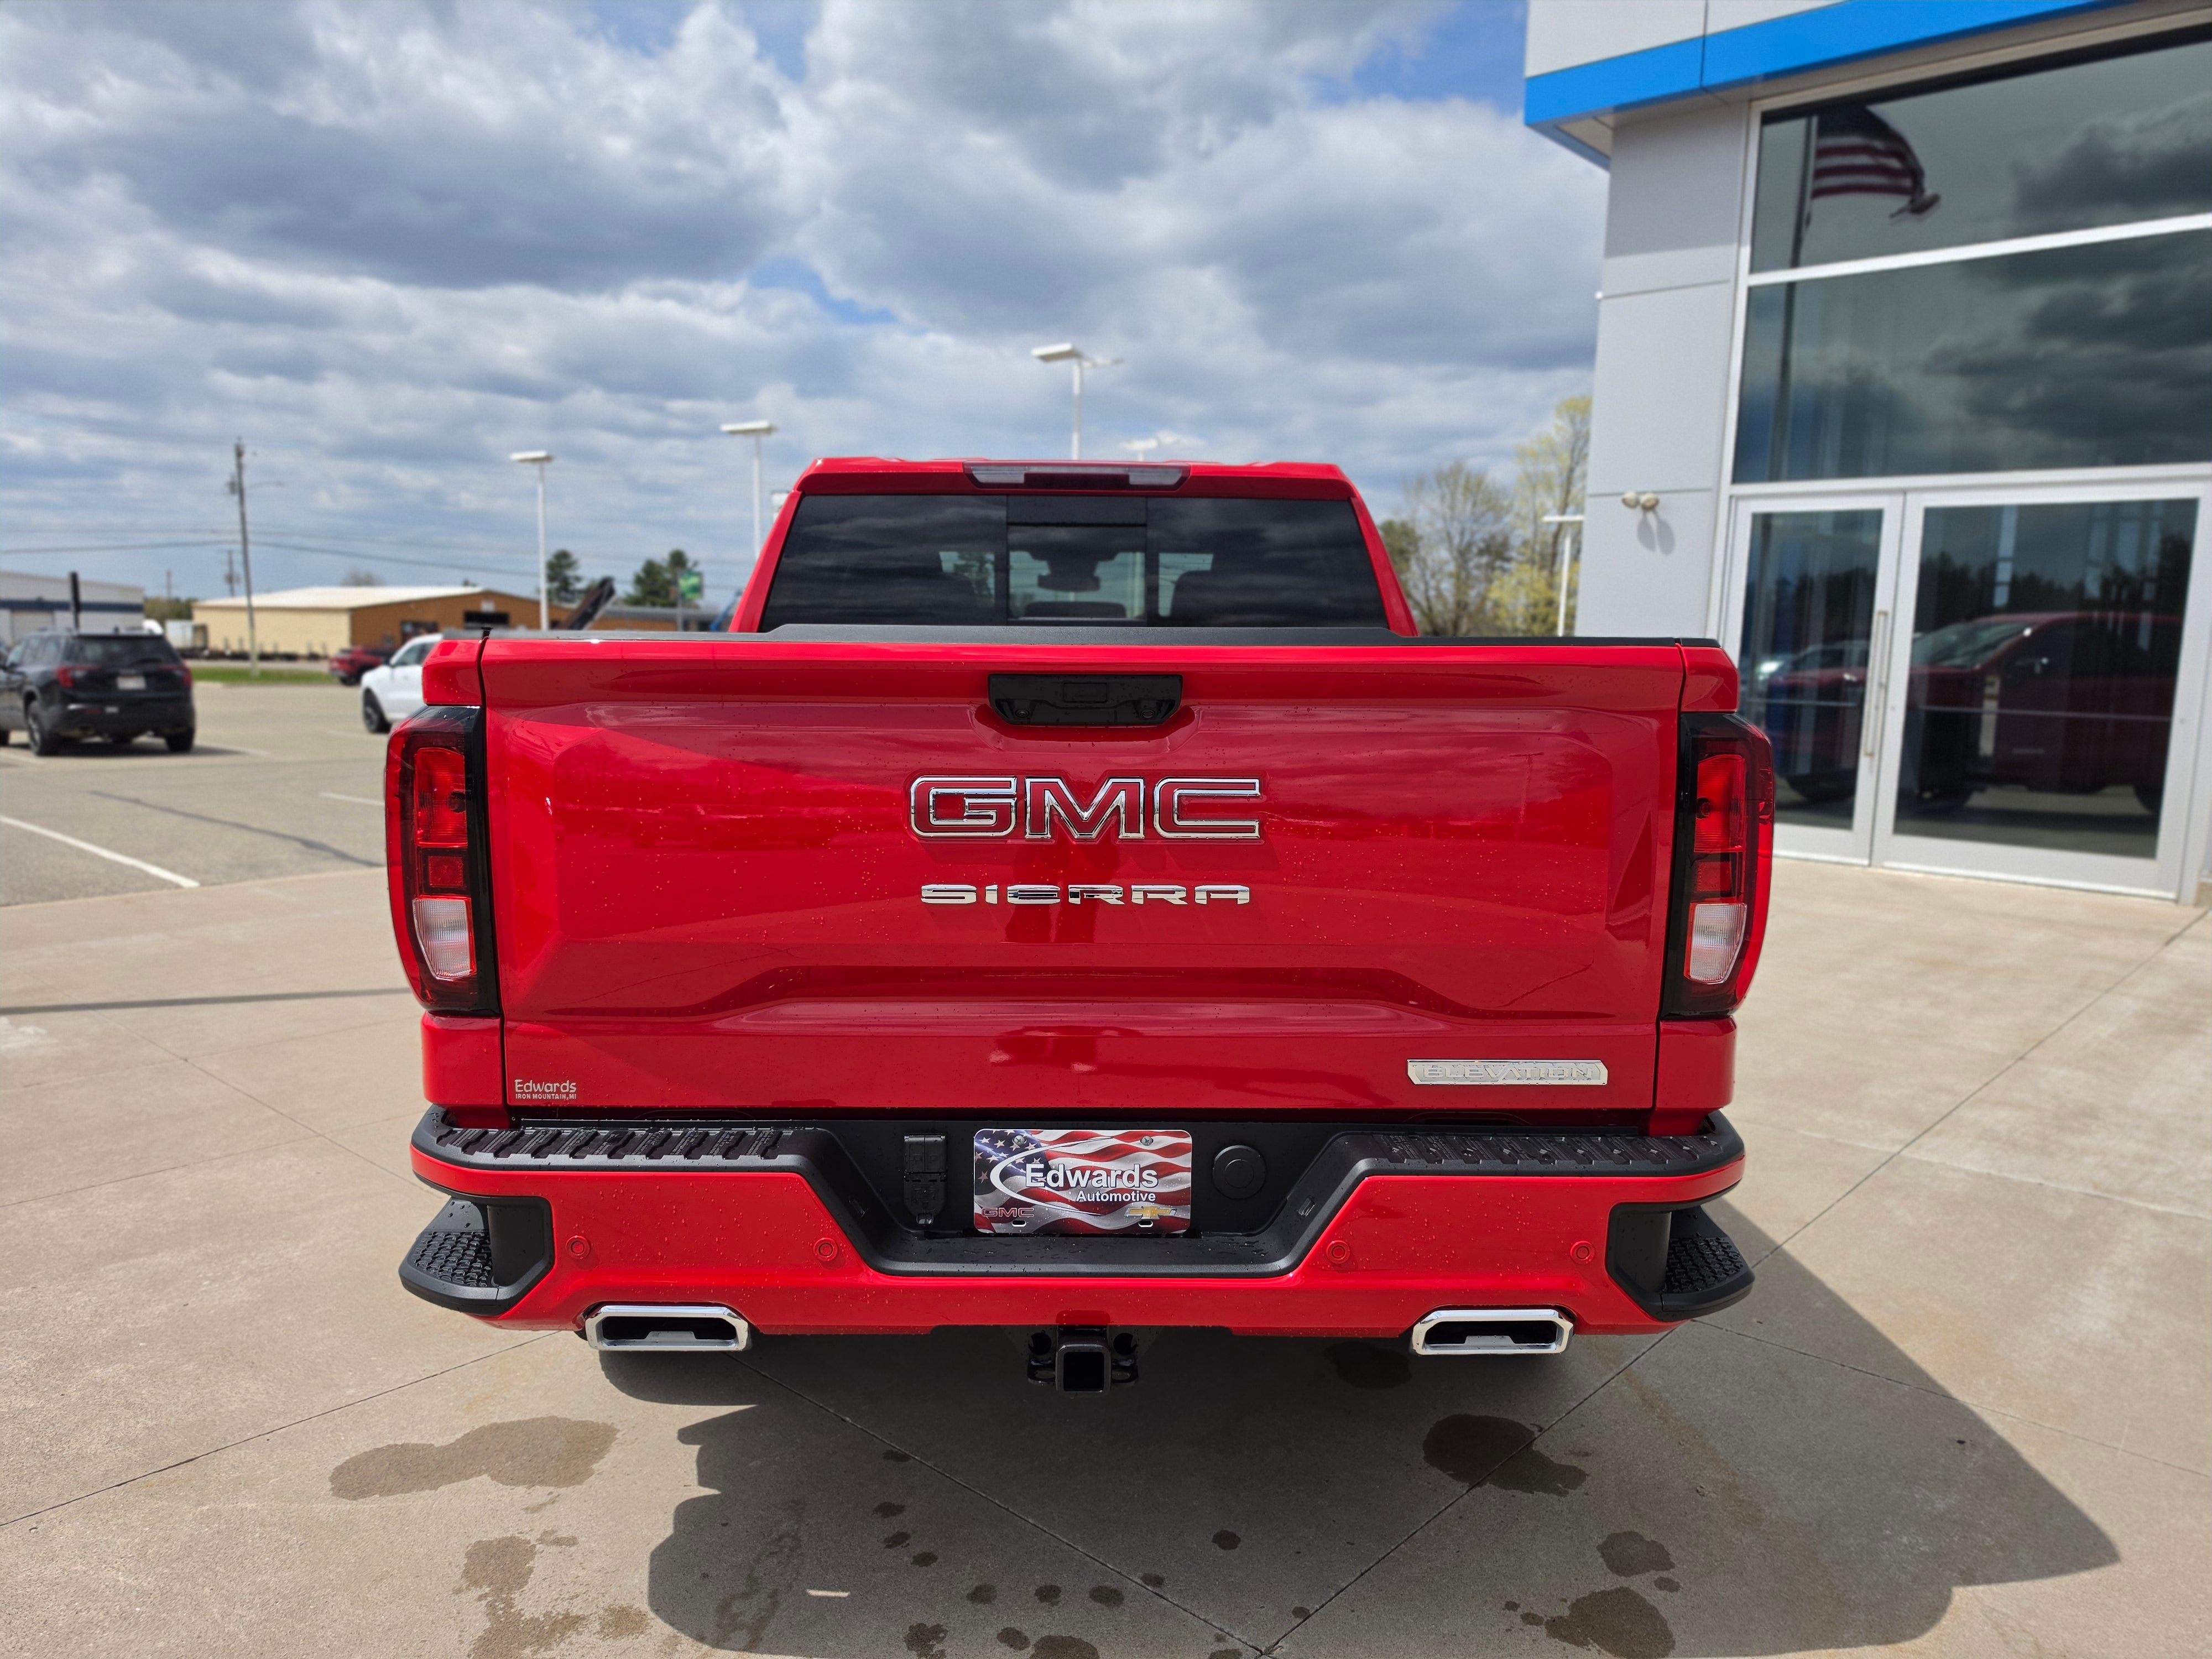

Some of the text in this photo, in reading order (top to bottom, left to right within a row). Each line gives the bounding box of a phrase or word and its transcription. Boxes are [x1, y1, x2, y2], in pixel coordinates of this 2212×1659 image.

[910, 776, 1260, 839] GMC
[921, 884, 1250, 905] SIERRA
[1423, 1066, 1593, 1079] ELEVATION
[514, 1079, 577, 1092] Edwards
[1025, 1164, 1159, 1188] Edwards
[1076, 1191, 1156, 1202] Automotive
[982, 1207, 1035, 1217] GMC
